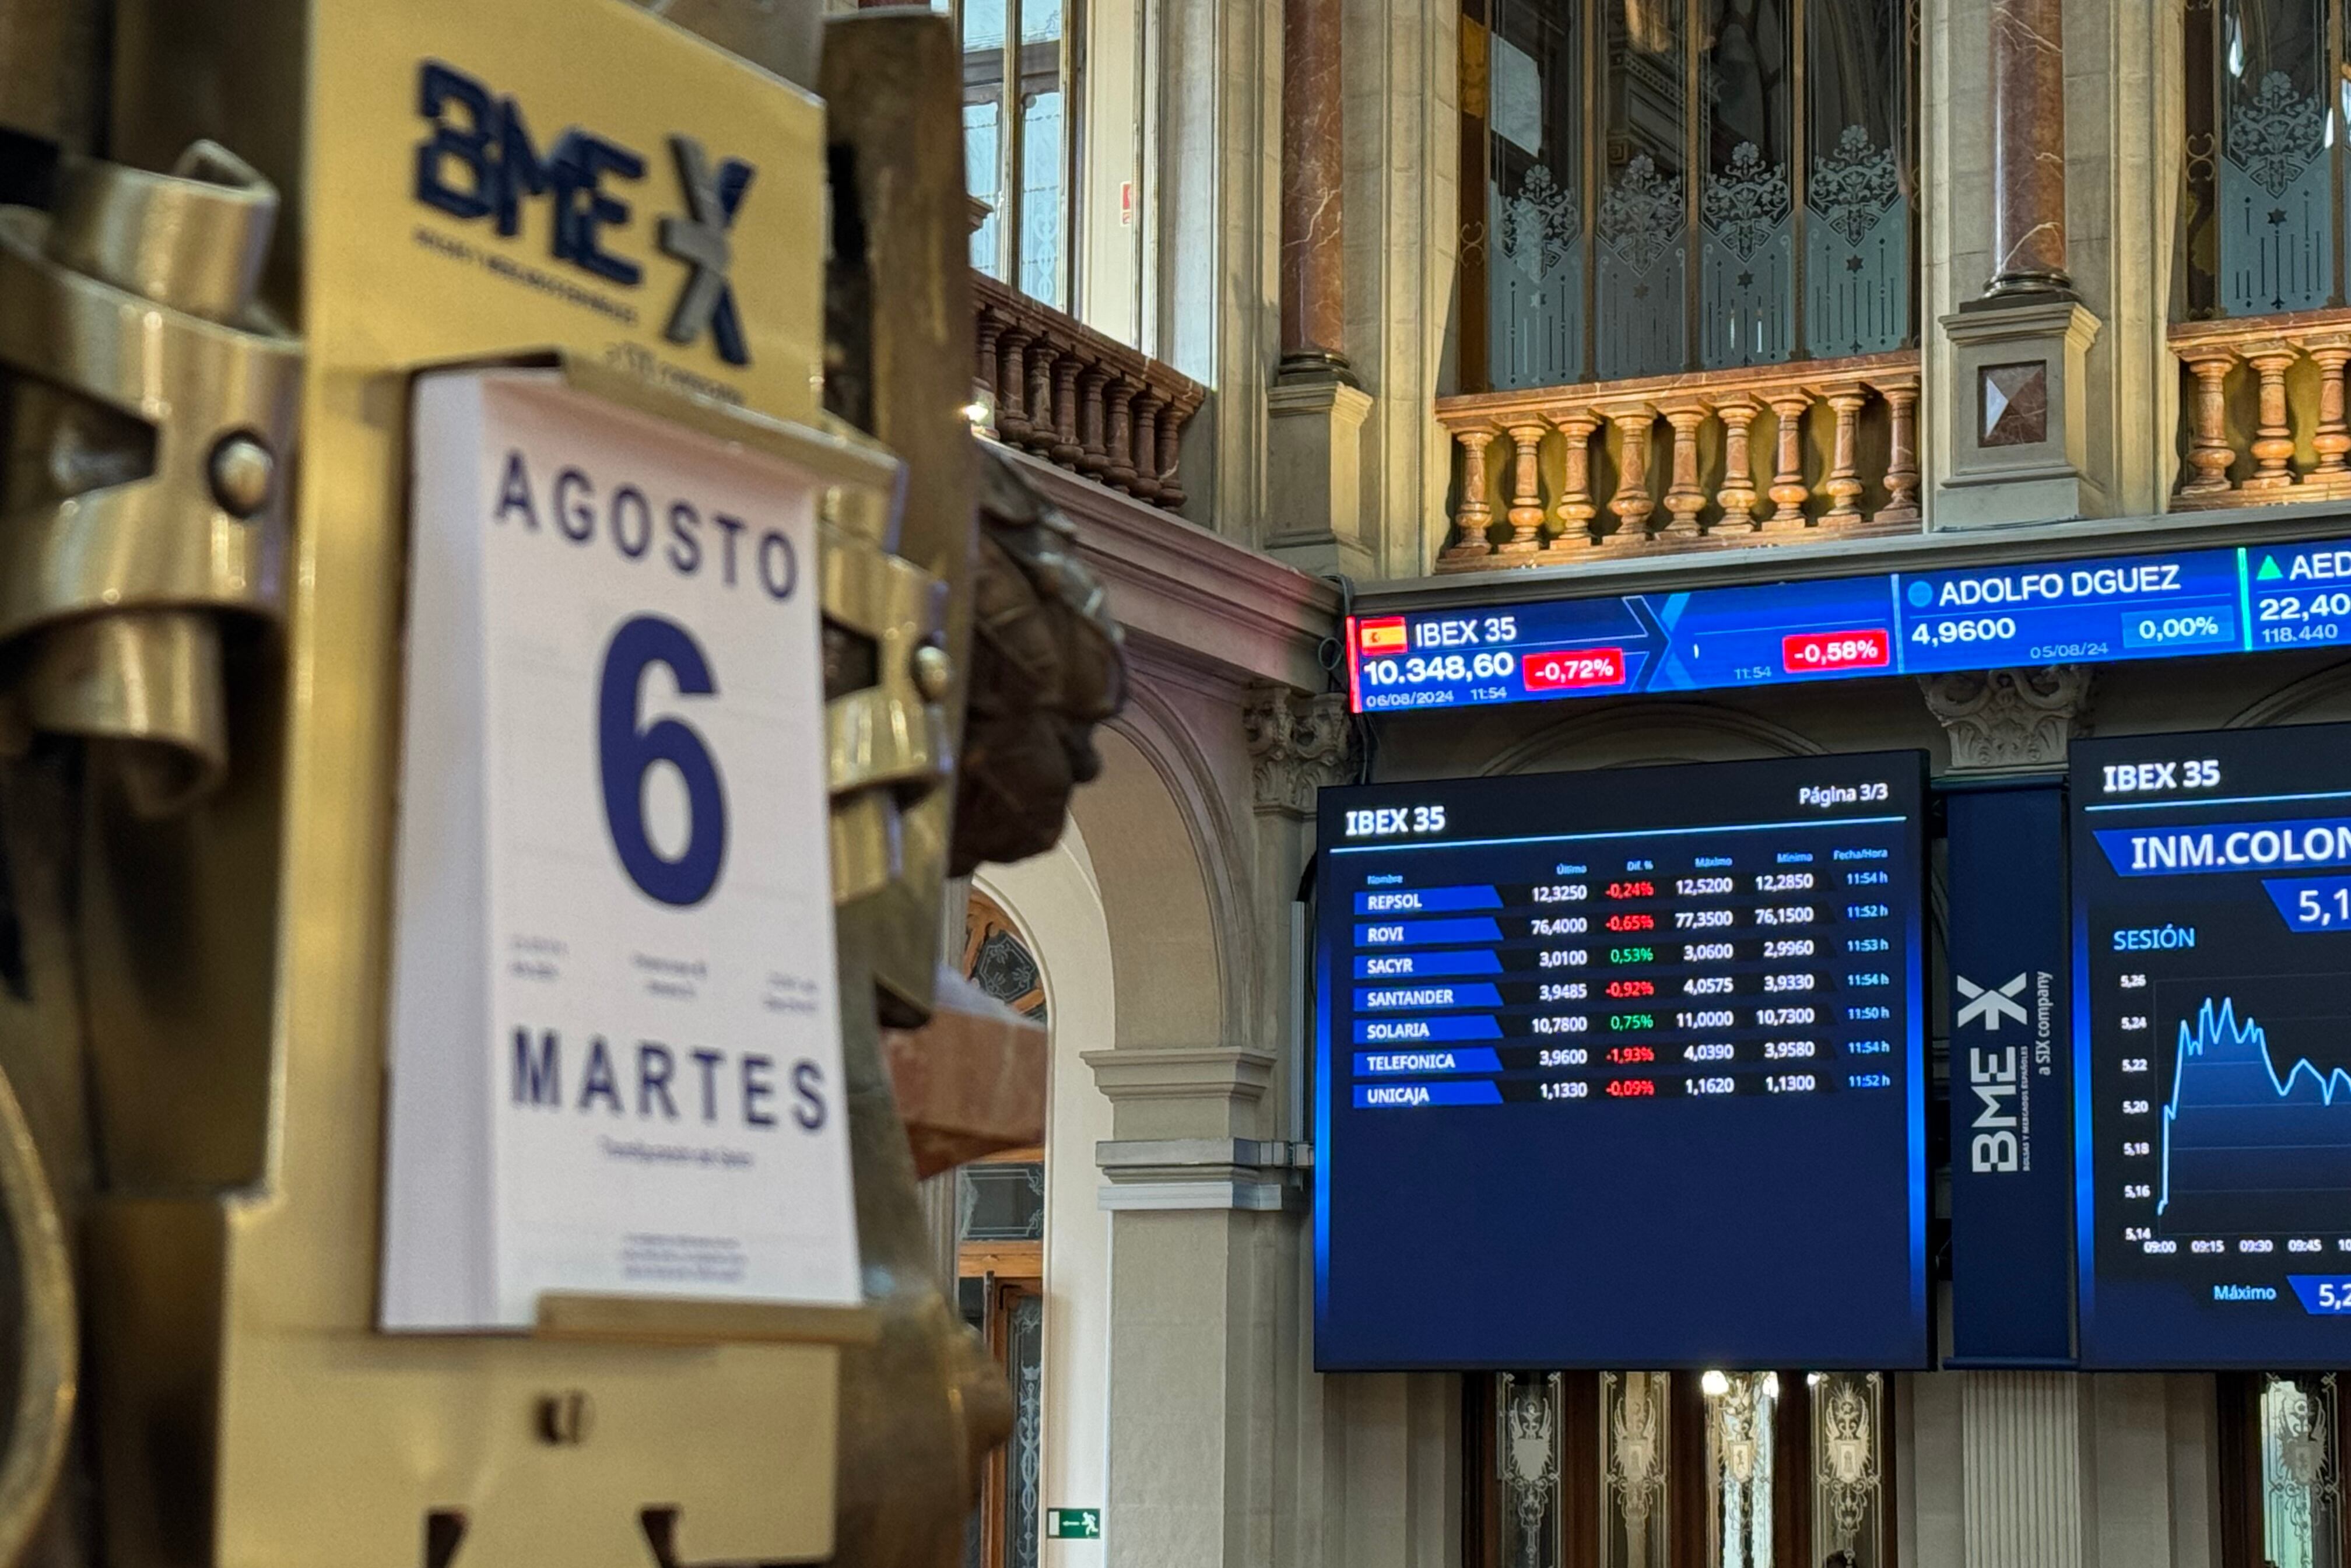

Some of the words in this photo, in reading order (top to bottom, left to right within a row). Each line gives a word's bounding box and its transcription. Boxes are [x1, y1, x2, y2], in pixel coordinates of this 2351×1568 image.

[493, 448, 798, 601] AGOSTO
[1939, 575, 2063, 607] ADOLFO
[2072, 565, 2181, 597] DGUEZ
[2259, 593, 2351, 622] 22,40
[1416, 620, 1477, 647] IBEX
[1484, 616, 1516, 643] 35
[1911, 618, 2016, 647] 4,9600
[2139, 618, 2219, 640] 0,00%
[2262, 624, 2338, 643] 118.440
[1794, 640, 1878, 664] -0,58%
[2030, 642, 2108, 660] 05/08/24
[1364, 651, 1514, 685] 10.348,60
[1535, 659, 1614, 682] -0,72%
[1734, 667, 1771, 679] 11:54
[1366, 690, 1454, 708] 06/08/2024
[1471, 686, 1507, 701] 11:54
[596, 610, 725, 908] 6
[2103, 762, 2177, 792] IBEX
[2183, 760, 2220, 787] 35
[1799, 786, 1857, 808] Página
[1860, 783, 1888, 801] 3/3
[1345, 809, 1408, 836] IBEX
[1413, 806, 1445, 832] 35
[1367, 894, 1422, 910] REPSOL
[1532, 885, 1587, 902] 12,3250
[1676, 877, 1733, 895] 12,5200
[1755, 874, 1813, 892] 12,2850
[2299, 889, 2351, 926] 5,1
[1367, 926, 1404, 942] ROVI
[1531, 918, 1588, 935] 76,4000
[1675, 910, 1733, 929] 77,3500
[1755, 907, 1813, 925] 76,1500
[2114, 924, 2195, 950] SESIÓN
[1367, 958, 1413, 974] SACYR
[1539, 950, 1587, 967] 3,0100
[1610, 948, 1654, 964] 0,53%
[1684, 943, 1734, 961] 3,0600
[1764, 940, 1814, 959] 2,9960
[1367, 990, 1453, 1007] SANTANDER
[1539, 983, 1587, 1001] 3,9485
[1684, 977, 1734, 995] 4,0575
[1764, 974, 1815, 992] 3,9330
[2120, 974, 2146, 988] 5,26
[2037, 971, 2054, 1037] company
[1367, 1022, 1430, 1040] SOLARIA
[1532, 1016, 1587, 1033] 10,7800
[1610, 1015, 1654, 1031] 0,75%
[1676, 1011, 1734, 1029] 11,0000
[1756, 1008, 1815, 1026] 10,7300
[2121, 1017, 2147, 1030] 5,24
[1367, 1054, 1455, 1071] TELEFONICA
[1539, 1049, 1588, 1066] 3,9600
[1684, 1044, 1734, 1062] 4,0390
[1764, 1041, 1815, 1060] 3,9580
[2036, 1040, 2051, 1064] SIX
[511, 1025, 829, 1130] MARTES
[2039, 1067, 2051, 1076] a
[2122, 1060, 2148, 1072] 5,22
[1367, 1087, 1430, 1106] UNICAJA
[1541, 1082, 1588, 1100] 1,1330
[1686, 1078, 1735, 1096] 1,1620
[1766, 1075, 1815, 1093] 1,1300
[2122, 1102, 2149, 1114] 5,20
[2124, 1143, 2149, 1156] 5,18
[2125, 1186, 2150, 1198] 5,16
[2125, 1228, 2151, 1241] 5,14
[2143, 1241, 2177, 1253] 09:00
[2191, 1240, 2224, 1253] 09:15
[2288, 1240, 2321, 1252] 09:45
[2214, 1285, 2276, 1300] Máximo
